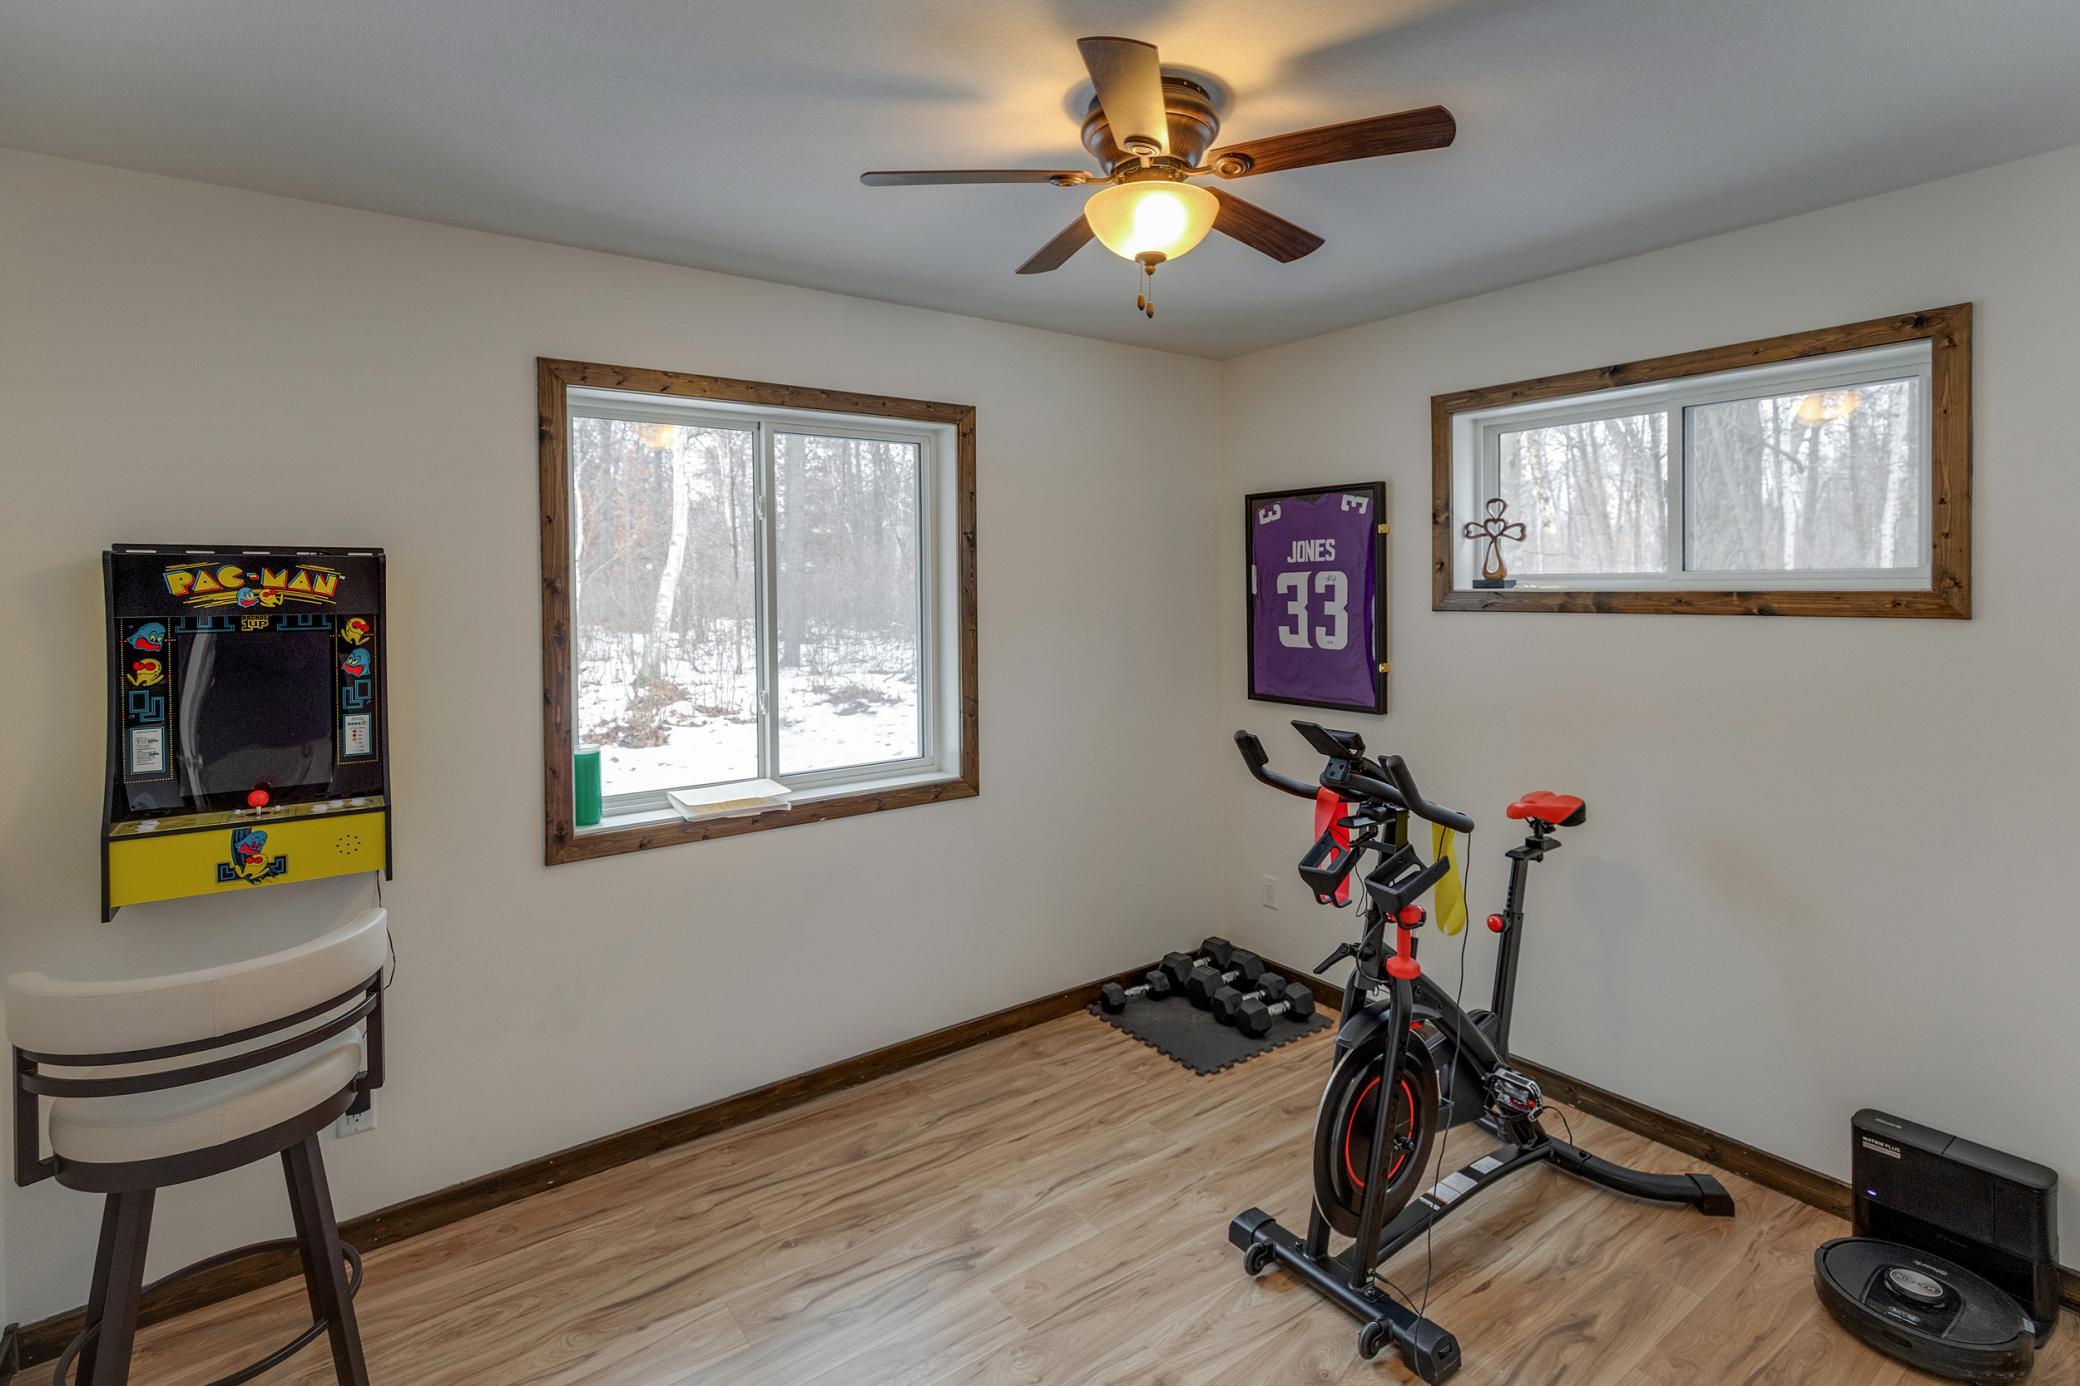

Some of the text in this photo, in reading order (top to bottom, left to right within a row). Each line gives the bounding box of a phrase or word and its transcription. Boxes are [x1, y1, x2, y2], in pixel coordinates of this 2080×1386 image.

[1287, 538, 1336, 563] JONES
[163, 564, 340, 597] PAC-MAN
[1276, 570, 1349, 651] 33
